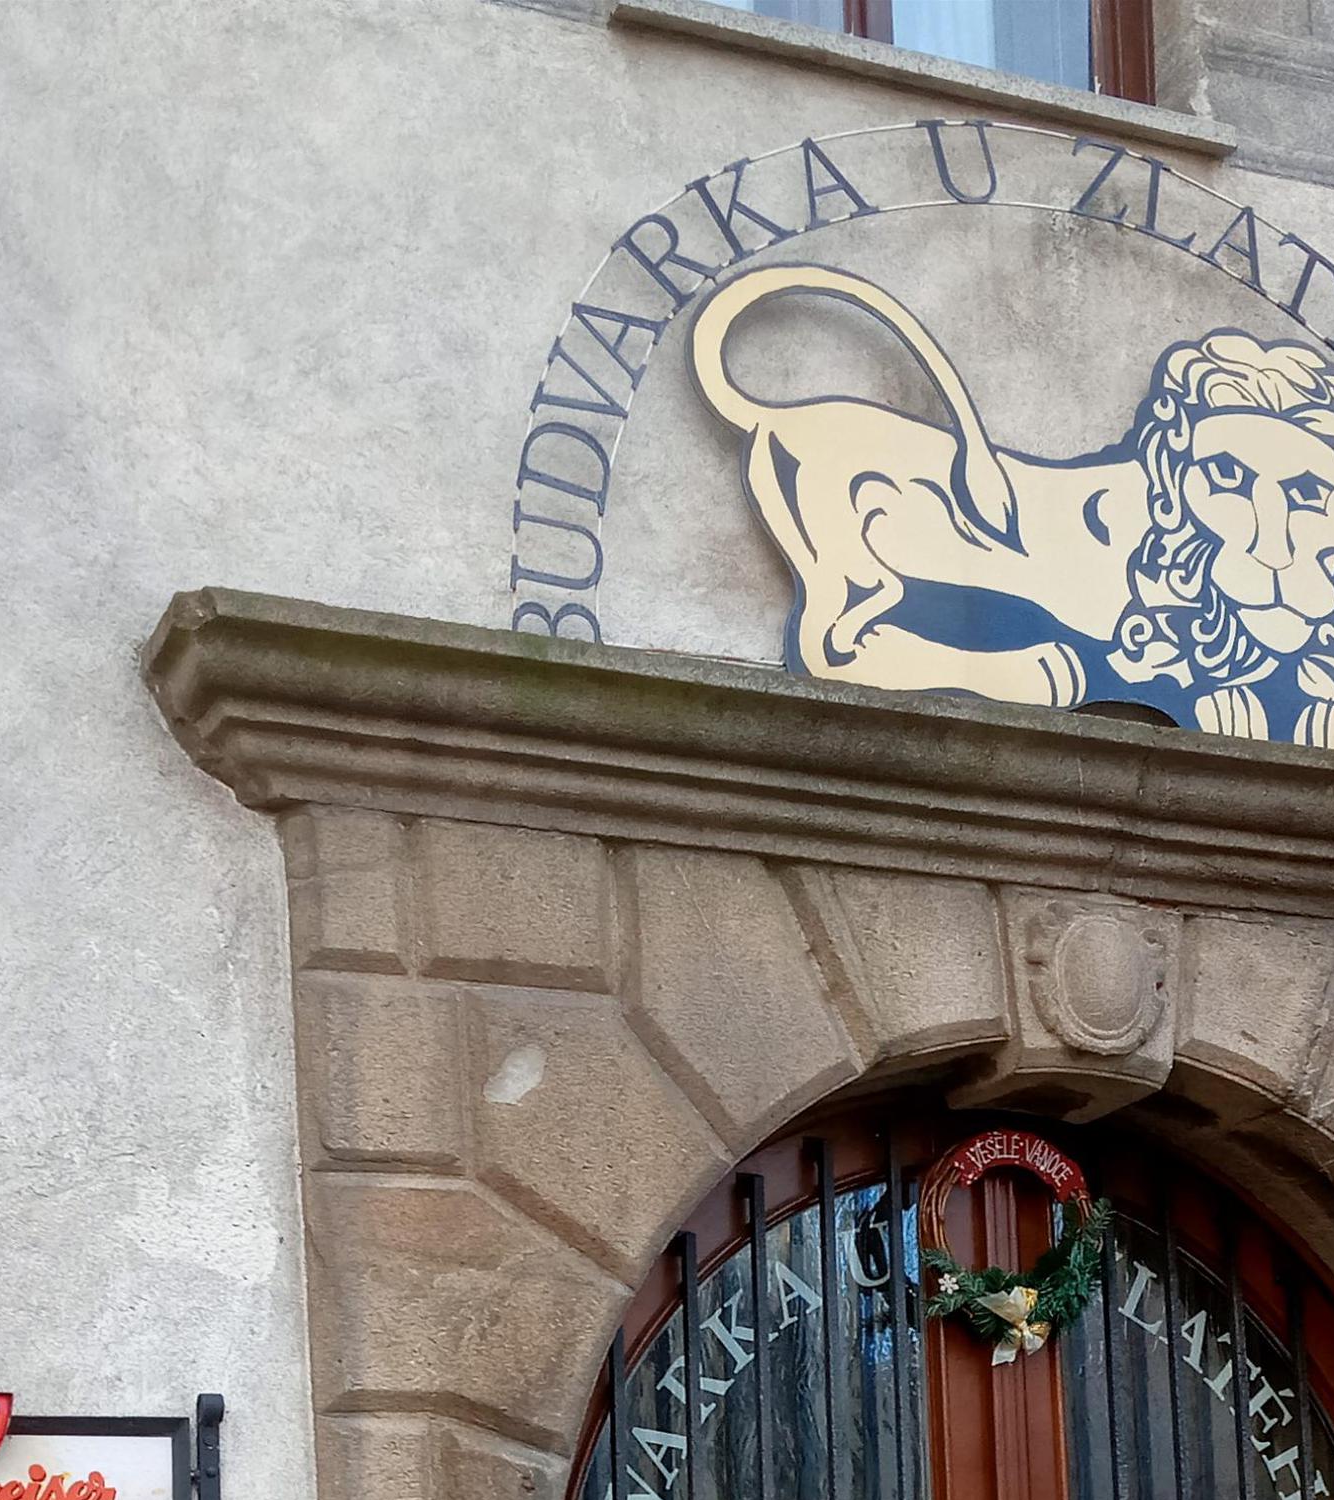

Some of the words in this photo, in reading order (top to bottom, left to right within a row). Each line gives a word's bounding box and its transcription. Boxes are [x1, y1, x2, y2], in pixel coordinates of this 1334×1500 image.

[510, 137, 879, 642] BUDVARKA
[917, 119, 999, 204] U
[1026, 1139, 1074, 1187] VÁNOCE
